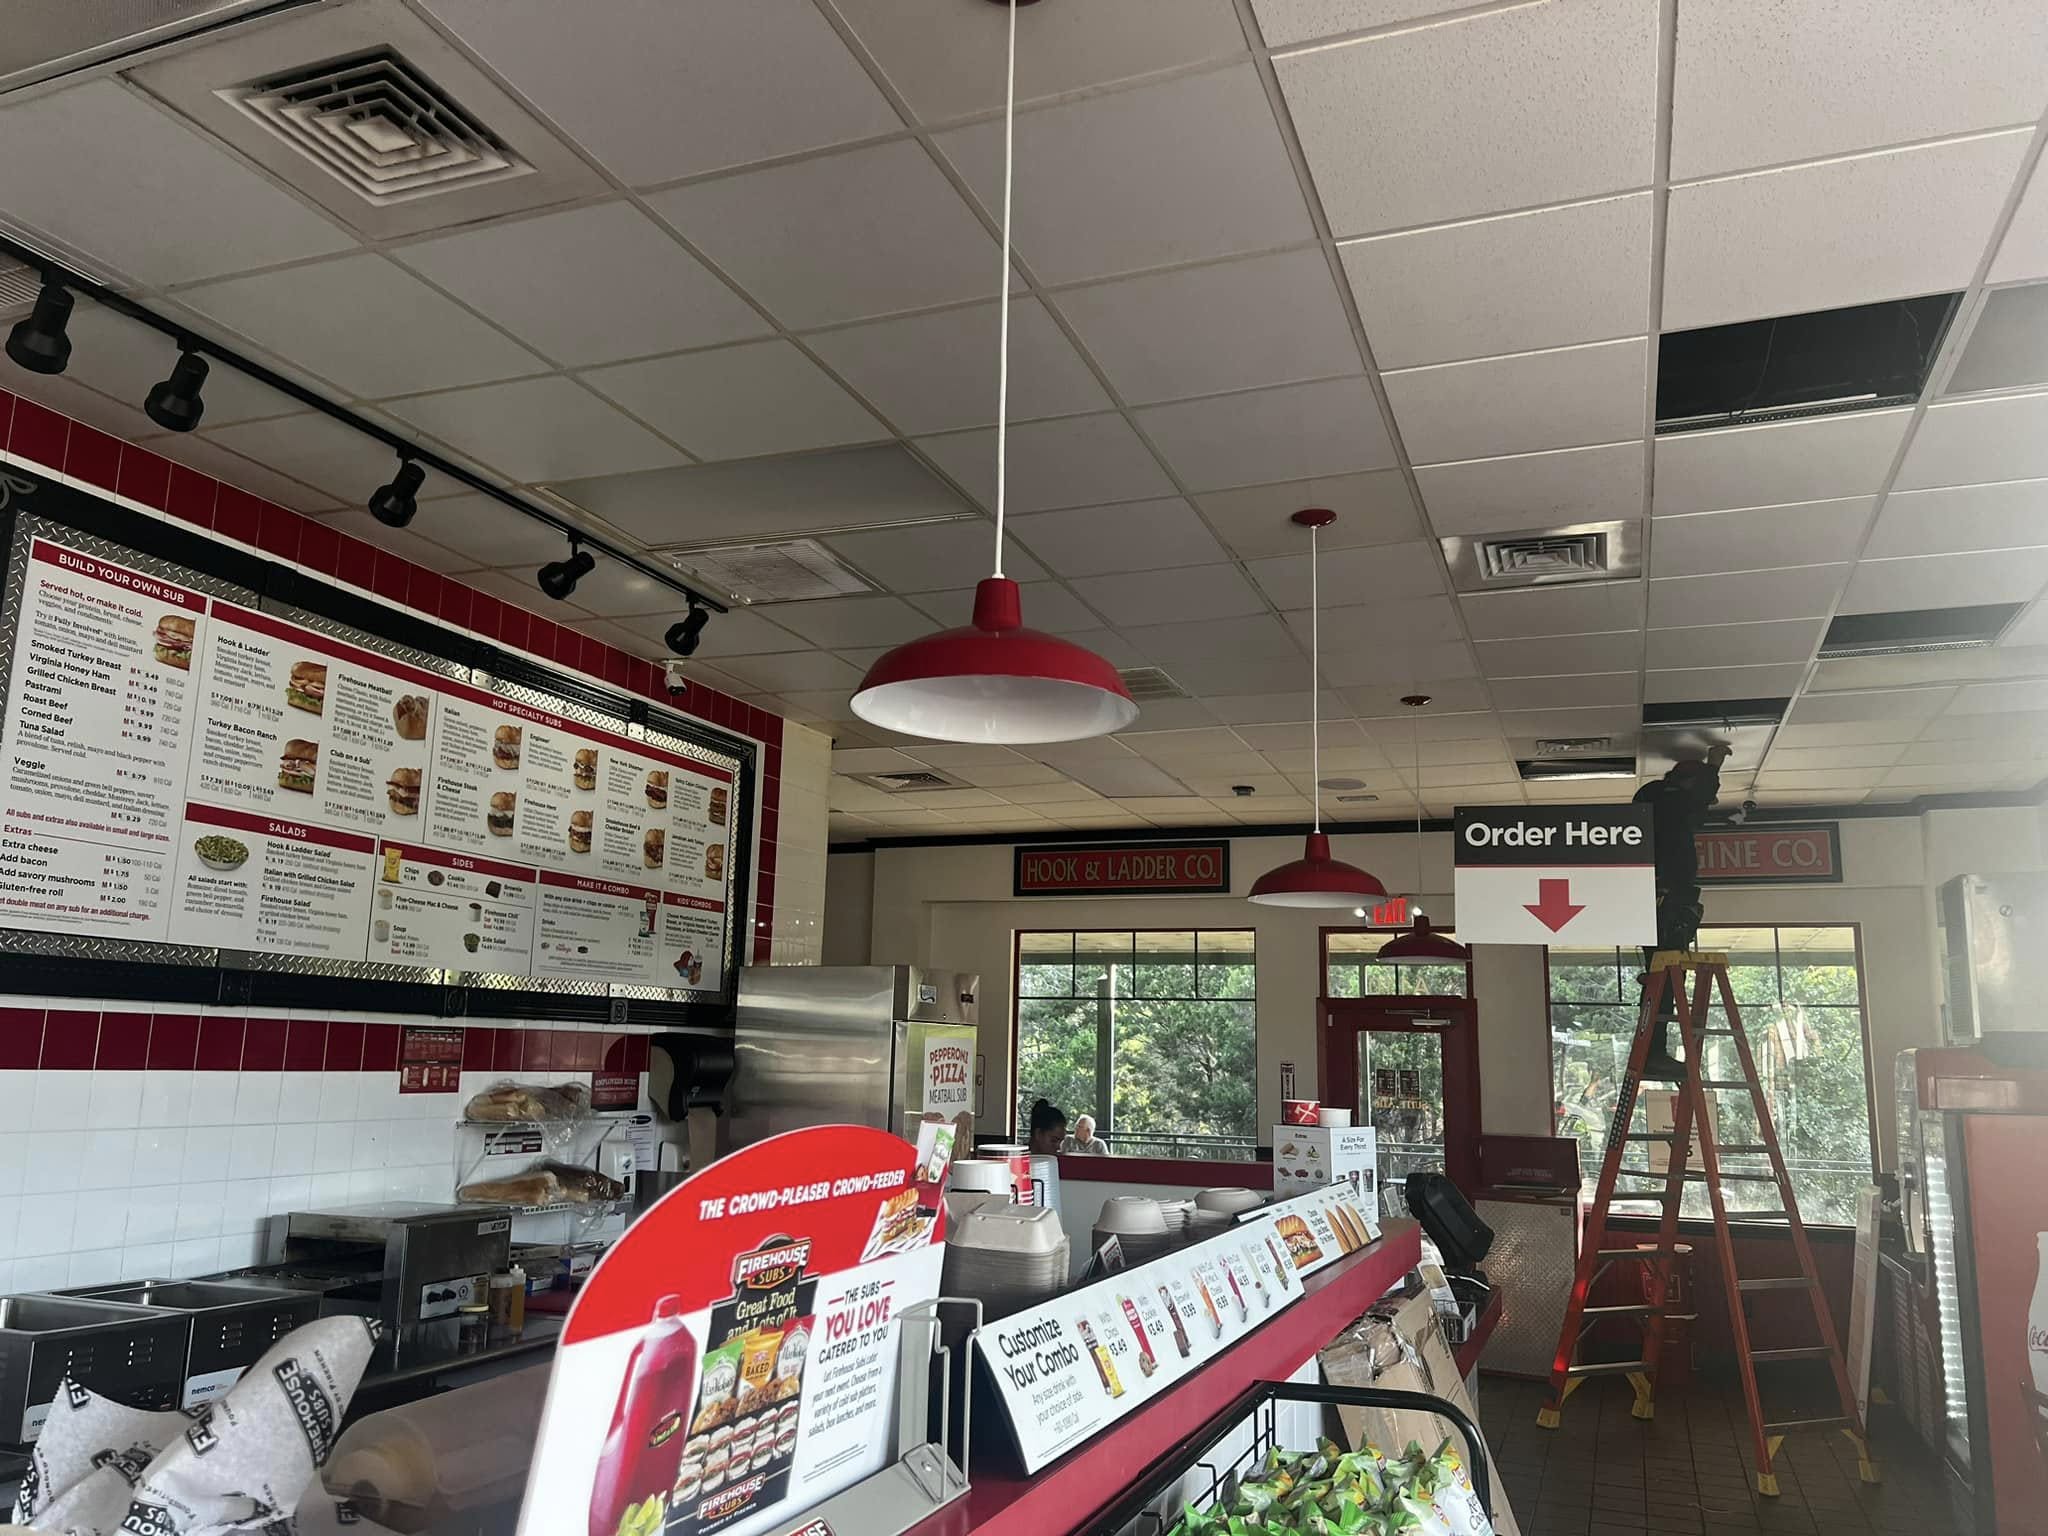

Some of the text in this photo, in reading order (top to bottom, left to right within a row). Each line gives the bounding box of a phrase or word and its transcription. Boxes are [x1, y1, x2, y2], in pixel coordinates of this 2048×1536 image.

[59, 554, 185, 603] BUILD YOUR OWN SUB
[40, 580, 68, 594] Served
[70, 589, 85, 600] hot,
[97, 598, 117, 610] make
[125, 607, 143, 618] cold.
[218, 636, 236, 646] Hook
[31, 640, 65, 655] Smoked
[67, 649, 95, 664] Turkey
[96, 658, 121, 670] Breast
[30, 653, 110, 681] Virginia Honey Ham
[25, 680, 62, 695] Pastrami
[27, 666, 117, 696] Grilled Chicken Breast
[338, 674, 367, 689] Firehouse
[23, 693, 68, 710] Roast Beef
[21, 707, 73, 725] Corned Beef
[492, 699, 562, 727] HOT SPECIALTY SUBS
[19, 720, 64, 737] Tuna Salad
[208, 718, 277, 740] Turkey Bacon Ranch
[15, 757, 46, 770] Veggie
[4, 824, 32, 836] Extras
[6, 808, 15, 816] All
[16, 811, 31, 819] subs
[45, 816, 65, 825] extras
[65, 819, 78, 827] also
[79, 821, 105, 831] available
[113, 826, 128, 835] small
[141, 830, 155, 840] large
[155, 833, 170, 841] sizes.
[268, 823, 307, 838] SALADS
[1464, 821, 1643, 848] Order Here
[2, 839, 58, 854] Extra cheese
[267, 840, 284, 850] Hook
[291, 845, 314, 855] Ladder
[314, 849, 331, 858] Salad
[1772, 838, 1822, 867] CO.
[0, 853, 48, 866] Add bacon
[452, 858, 474, 869] SIDES
[1027, 854, 1217, 882] HOOK & LADDER CO.
[18, 871, 46, 882] savory
[48, 874, 95, 887] mushrooms
[198, 876, 217, 885] salads
[264, 868, 283, 877] Italian
[284, 871, 296, 879] with
[297, 872, 316, 883] Grilled
[317, 876, 339, 886] Chicken
[340, 880, 355, 888] Salad
[49, 888, 64, 897] roll
[577, 880, 594, 890] MAKE
[608, 885, 630, 895] COMBO
[261, 895, 311, 907] Firehouse Salad
[930, 1048, 968, 1064] PEPPERONI
[933, 1064, 965, 1086] PIZZA
[929, 1088, 966, 1104] MEATBALL SUB
[699, 1170, 905, 1221] THE CROWD-PLEASER CROWD-FEEDER
[738, 1245, 809, 1283] FIREHOUSE
[758, 1267, 785, 1284] SUBS
[844, 1281, 880, 1305] THE SUBS
[736, 1289, 796, 1320] Great Food
[1181, 1303, 1197, 1318] $3.99
[826, 1296, 891, 1344] YOU LOVE
[1147, 1319, 1165, 1336] $3.49
[818, 1325, 889, 1364] CATERED TO YOU
[998, 1318, 1063, 1359] Customize
[1109, 1338, 1128, 1357] $3.49
[746, 1362, 769, 1377] BAKED
[1004, 1342, 1079, 1391] Your Combo
[192, 1384, 216, 1395] nemco
[279, 1360, 326, 1463] FIREHOUSE
[309, 1389, 331, 1429] SUBS
[699, 1475, 764, 1519] FIREHOUSE
[720, 1496, 743, 1514] SUBS
